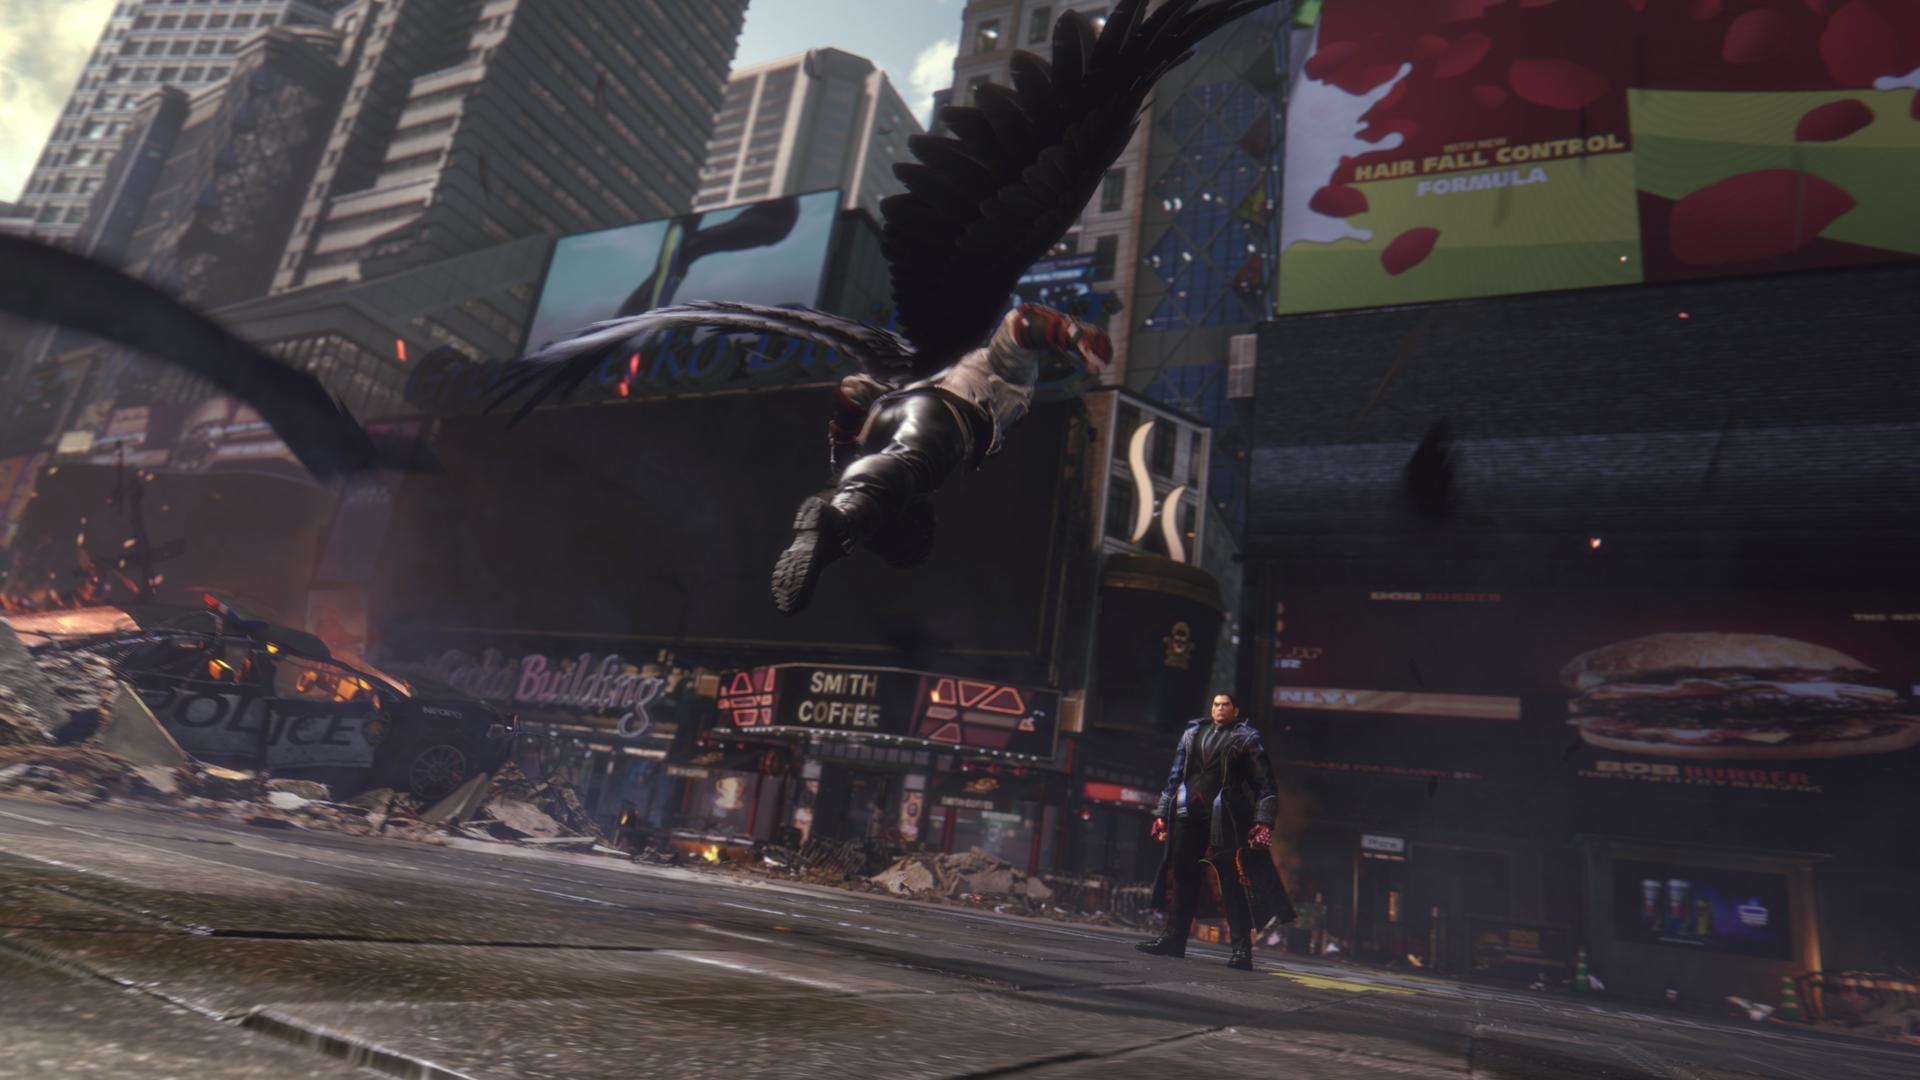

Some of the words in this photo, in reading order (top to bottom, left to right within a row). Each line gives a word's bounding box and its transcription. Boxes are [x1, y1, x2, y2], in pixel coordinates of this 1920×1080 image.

[1354, 158, 1416, 182] HAIR
[1422, 151, 1489, 174] FALL
[1495, 133, 1626, 164] CONTROL
[1416, 167, 1549, 197] FORMULA
[515, 650, 666, 738] Building
[809, 669, 879, 698] SMITH
[1273, 688, 1358, 706] NLY!
[797, 698, 882, 729] COFFEE
[1594, 760, 1679, 776] BOB
[1683, 766, 1810, 787] BURGER
